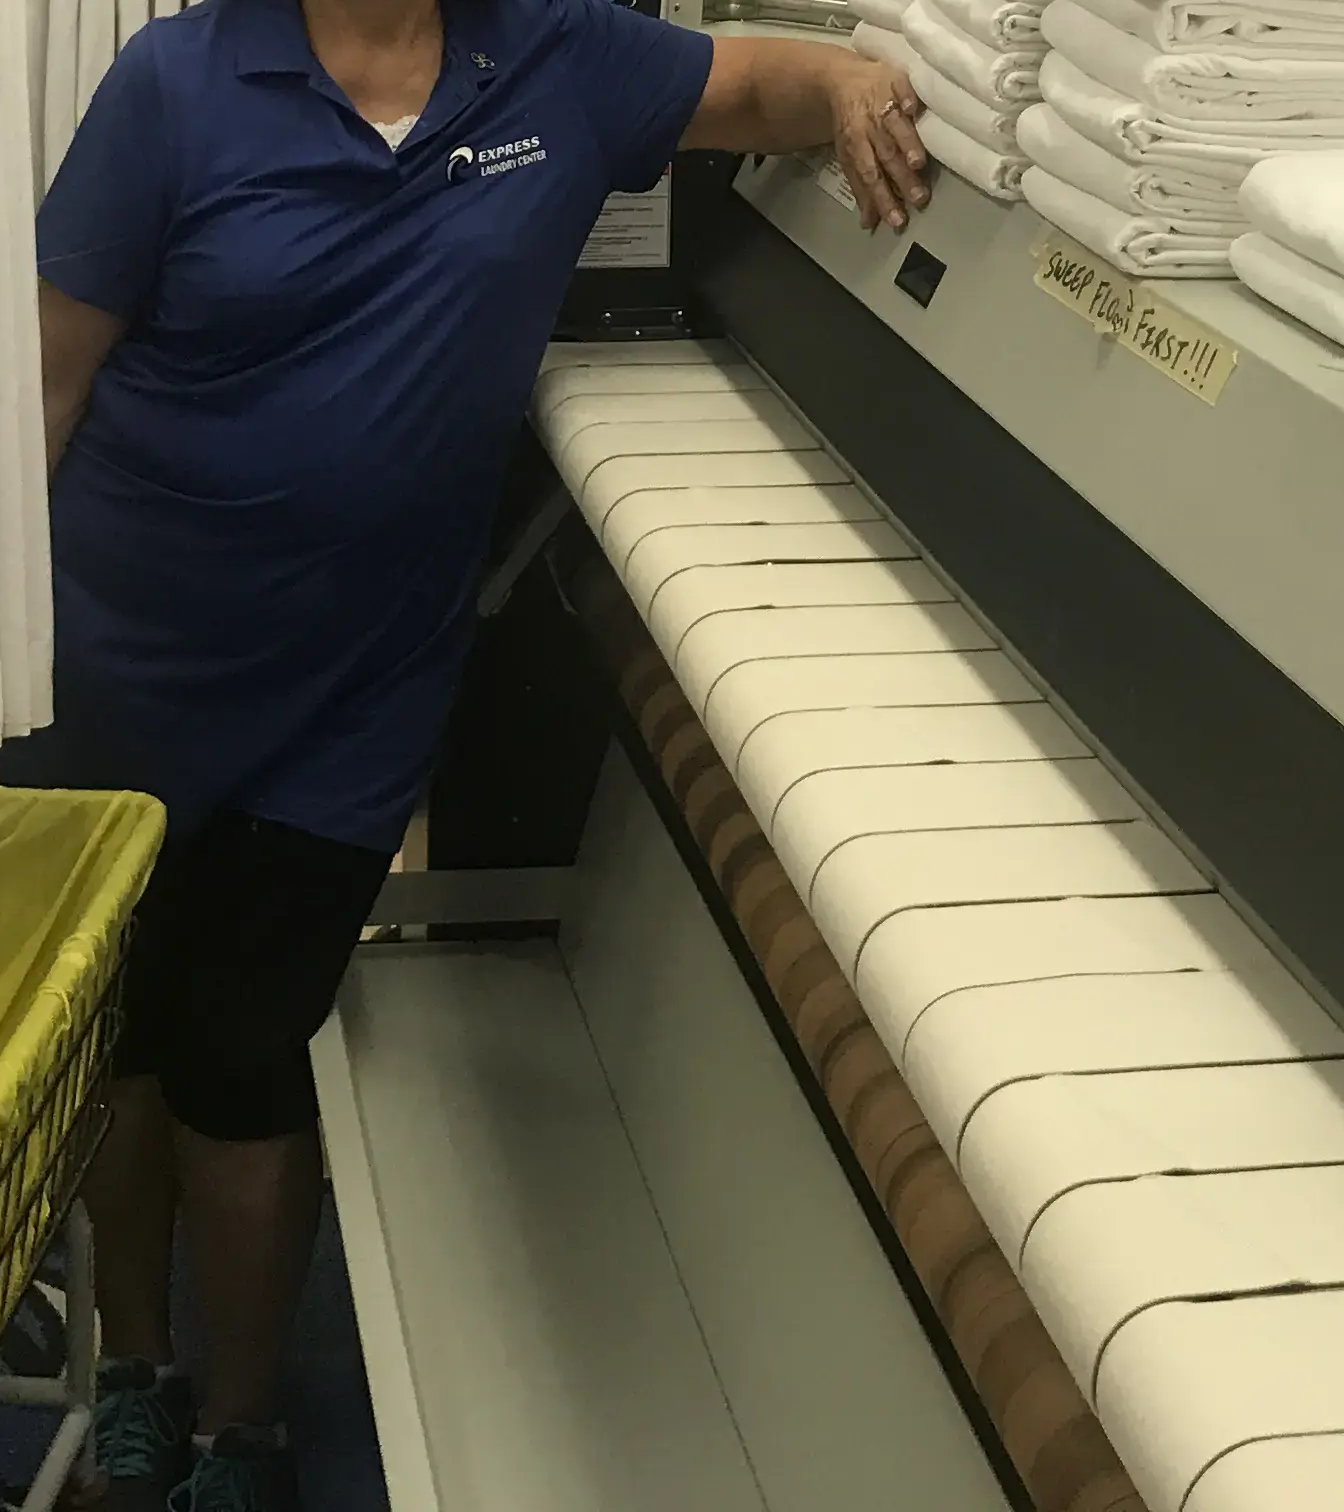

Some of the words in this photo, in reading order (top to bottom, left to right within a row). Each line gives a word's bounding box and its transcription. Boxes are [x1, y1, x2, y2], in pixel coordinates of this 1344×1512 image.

[478, 136, 541, 163] EXPRESS
[480, 159, 517, 177] LAUNDRY
[517, 149, 547, 167] CENTER
[1043, 251, 1095, 300] SWEEP
